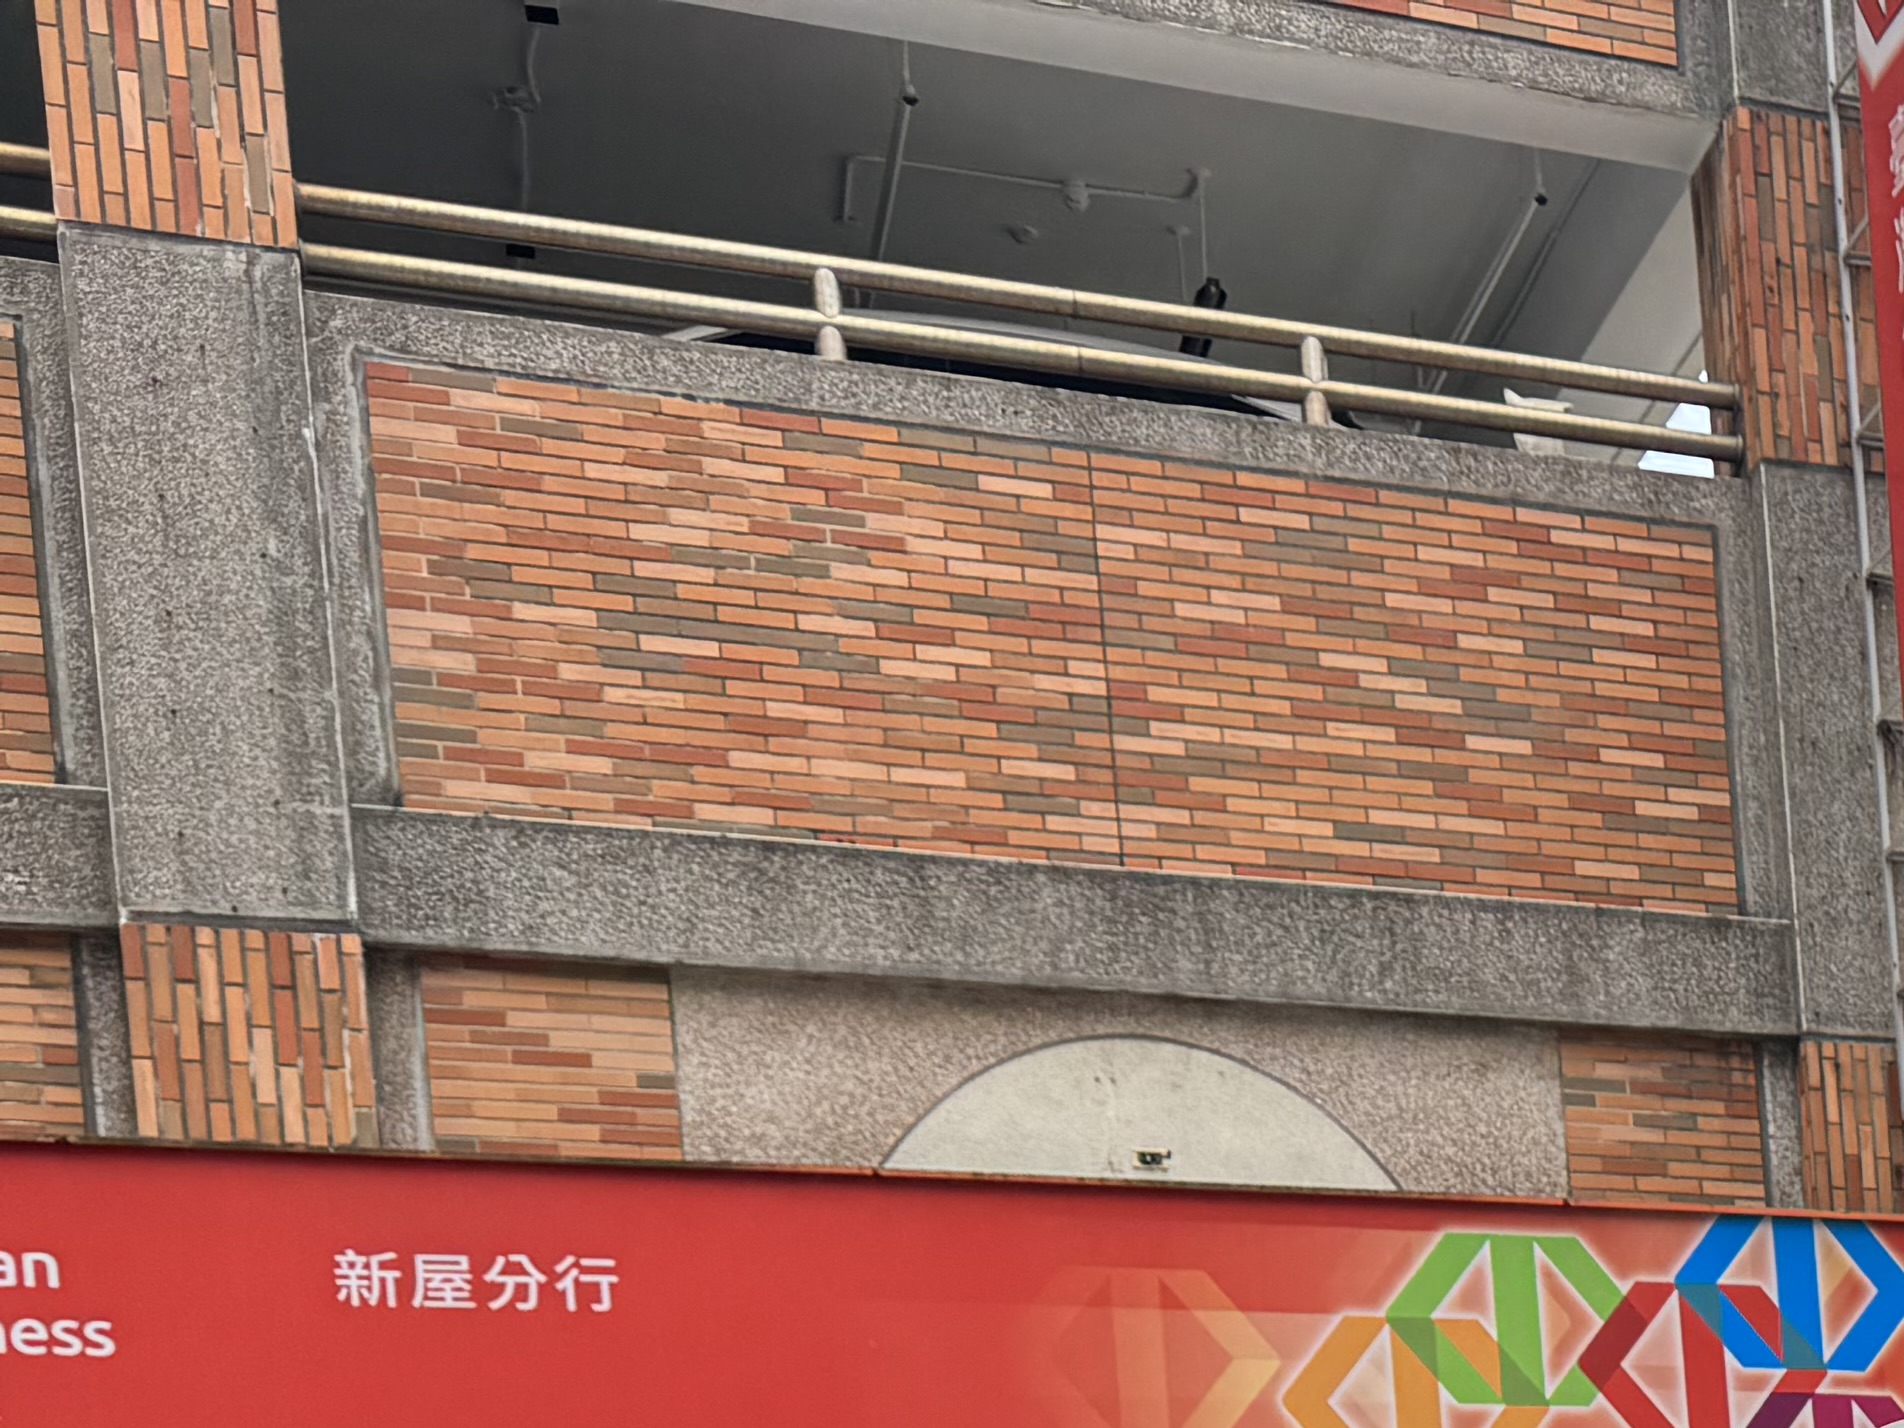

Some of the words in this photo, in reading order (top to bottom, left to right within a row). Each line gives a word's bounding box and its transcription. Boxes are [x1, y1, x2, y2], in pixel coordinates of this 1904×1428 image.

[333, 1248, 620, 1313] 新屋分行
[0, 1318, 116, 1358] ess
